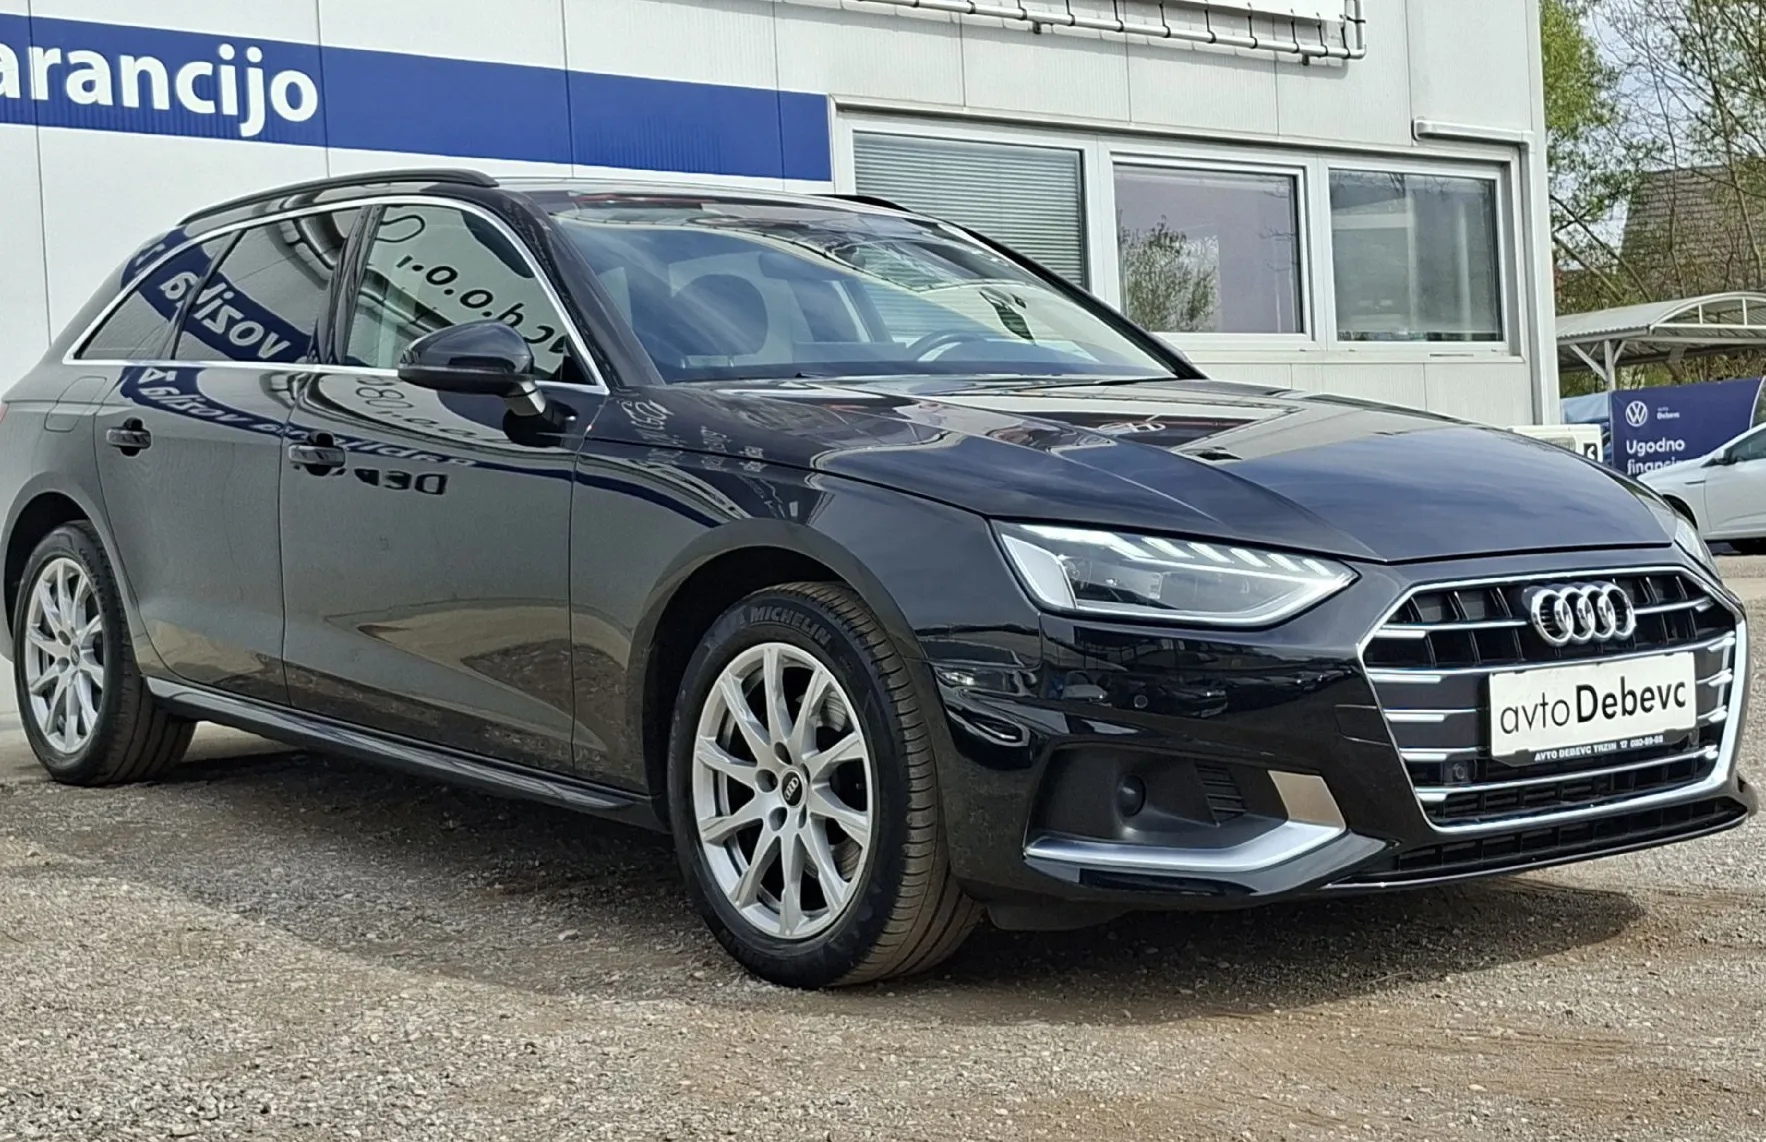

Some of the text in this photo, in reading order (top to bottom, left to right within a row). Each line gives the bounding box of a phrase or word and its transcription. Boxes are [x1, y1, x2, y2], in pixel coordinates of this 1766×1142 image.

[0, 43, 318, 137] arancijo
[1626, 436, 1686, 457] Ugodno
[750, 605, 832, 646] MICHELIN
[1500, 676, 1686, 735] avto Debevc
[1534, 749, 1558, 762] AVTO
